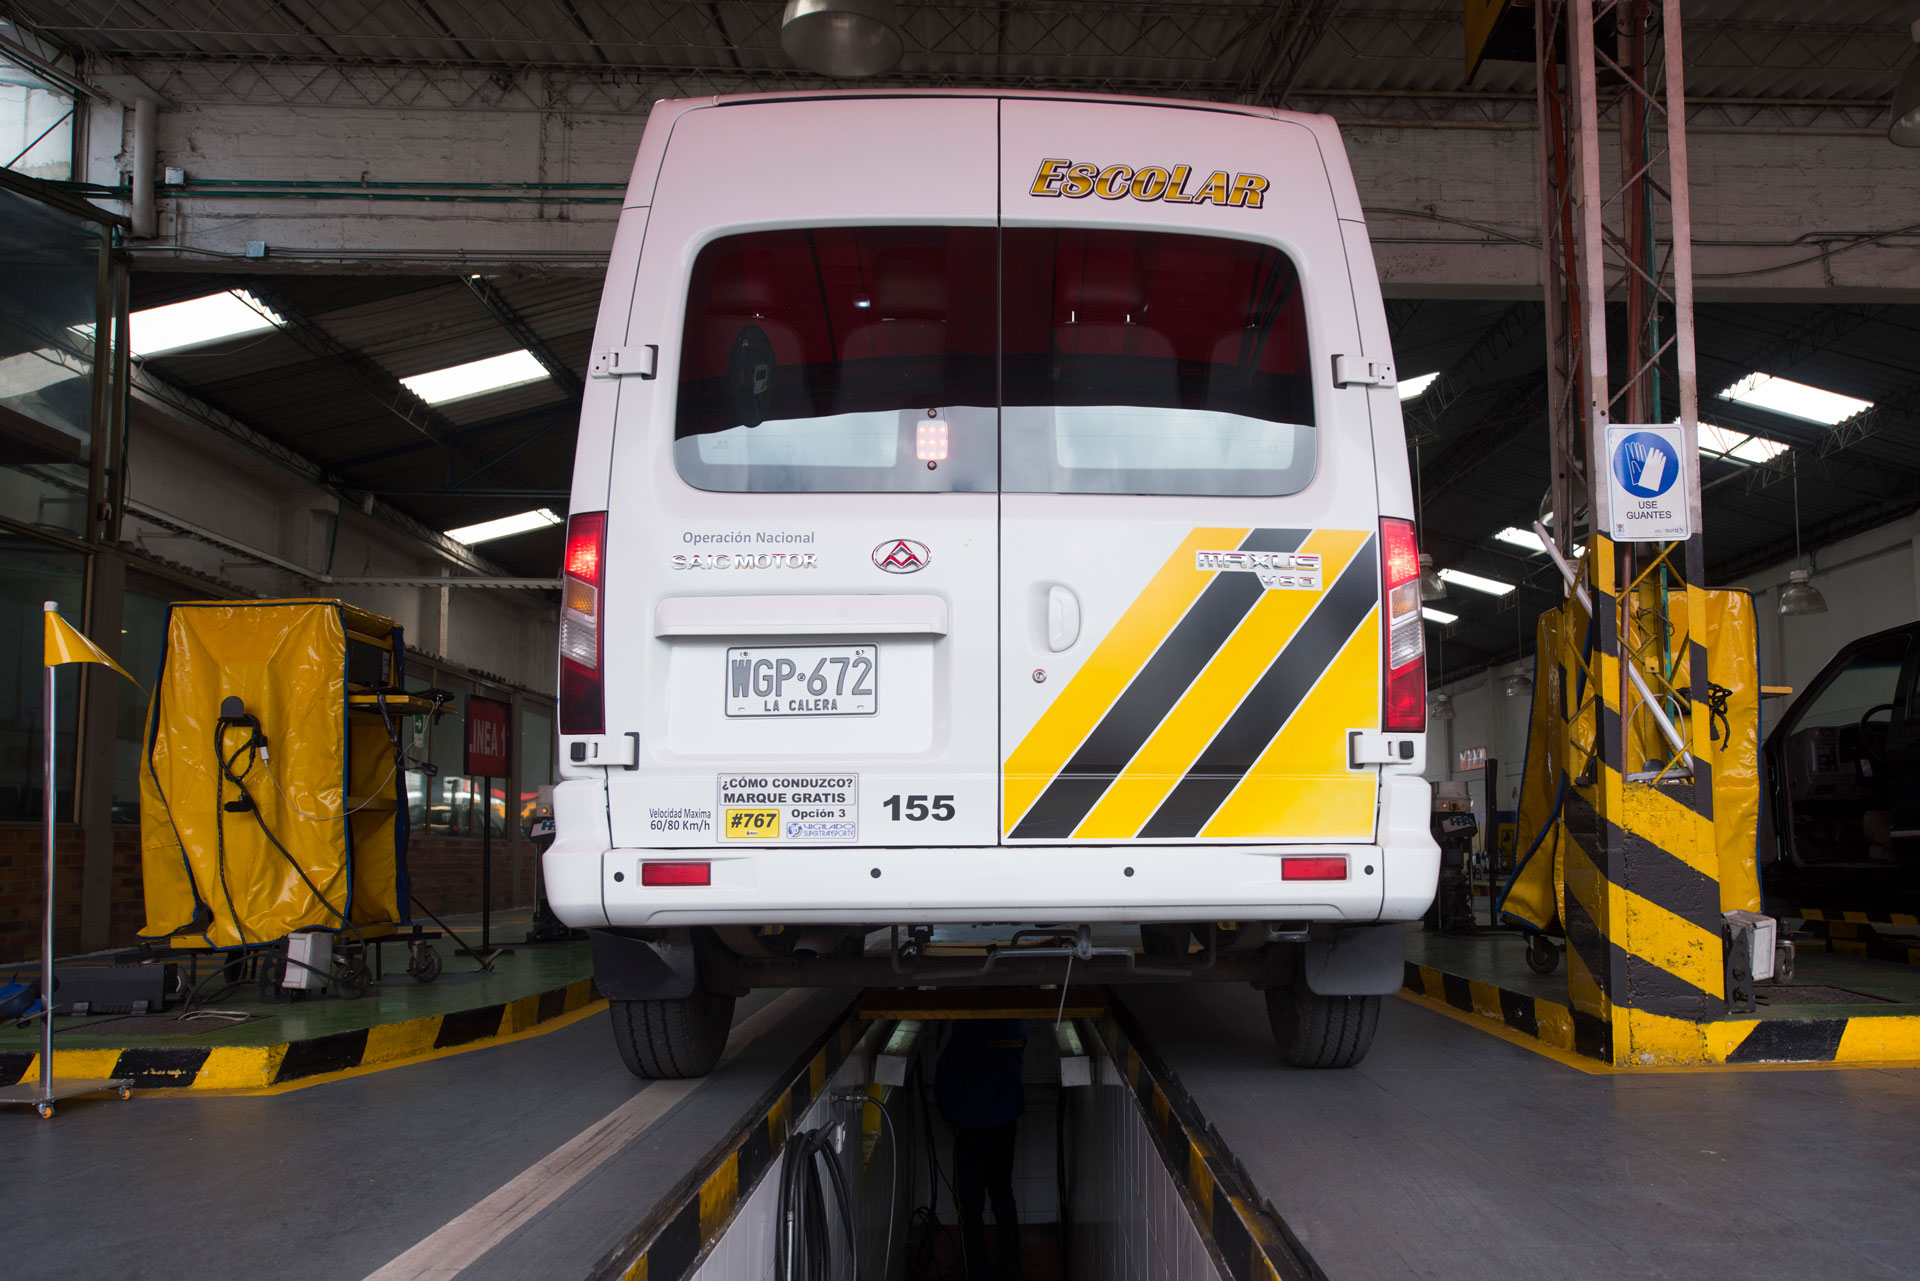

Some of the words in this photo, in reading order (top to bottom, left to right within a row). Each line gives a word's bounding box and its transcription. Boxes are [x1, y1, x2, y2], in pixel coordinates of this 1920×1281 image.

[1029, 158, 1270, 209] ESCOLAR
[1638, 501, 1658, 509] USE
[1626, 511, 1672, 520] GUANTES
[682, 531, 752, 546] Operación
[756, 531, 815, 544] Nacional
[671, 554, 731, 570] SAIC
[734, 553, 818, 570] MOTOR
[1198, 552, 1320, 571] MAXUS
[1262, 575, 1316, 588] V80
[764, 700, 780, 712] LA
[788, 699, 838, 711] CALERA
[500, 724, 506, 757] 1
[722, 776, 770, 790] ¿CÓMO
[772, 778, 854, 788] CONDUZCO?
[723, 793, 787, 804] MARQUE
[791, 793, 846, 803] GRATIS
[649, 808, 682, 819] Velocidad
[684, 809, 711, 819] Maxima
[883, 794, 955, 821] 155
[731, 813, 777, 829] #767
[791, 809, 835, 820] Opción
[838, 809, 846, 818] 3
[650, 820, 680, 832] 60/80
[682, 819, 711, 832] Km/h
